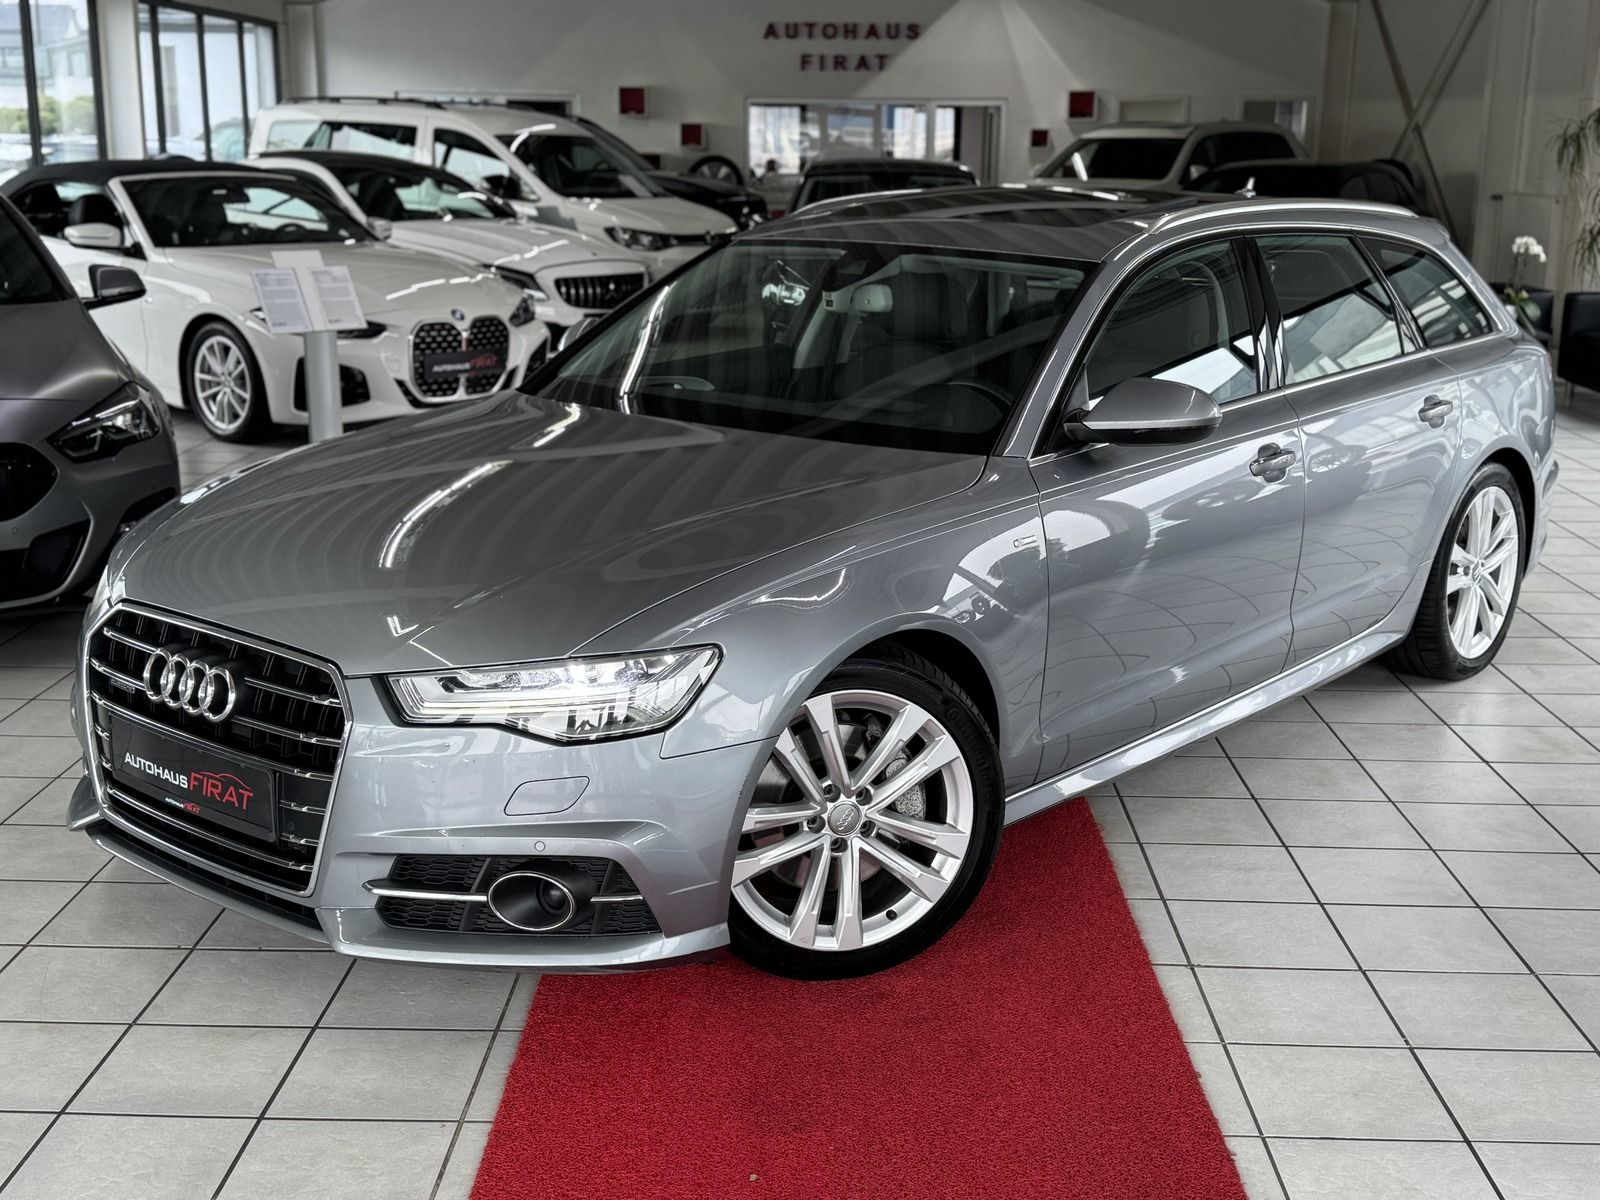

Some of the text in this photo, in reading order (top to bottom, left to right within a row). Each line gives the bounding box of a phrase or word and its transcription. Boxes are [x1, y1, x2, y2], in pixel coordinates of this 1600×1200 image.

[763, 22, 922, 40] AUTOHAUS
[800, 54, 889, 71] FIRAT
[124, 752, 254, 810] AUTOHAUS FIRAT
